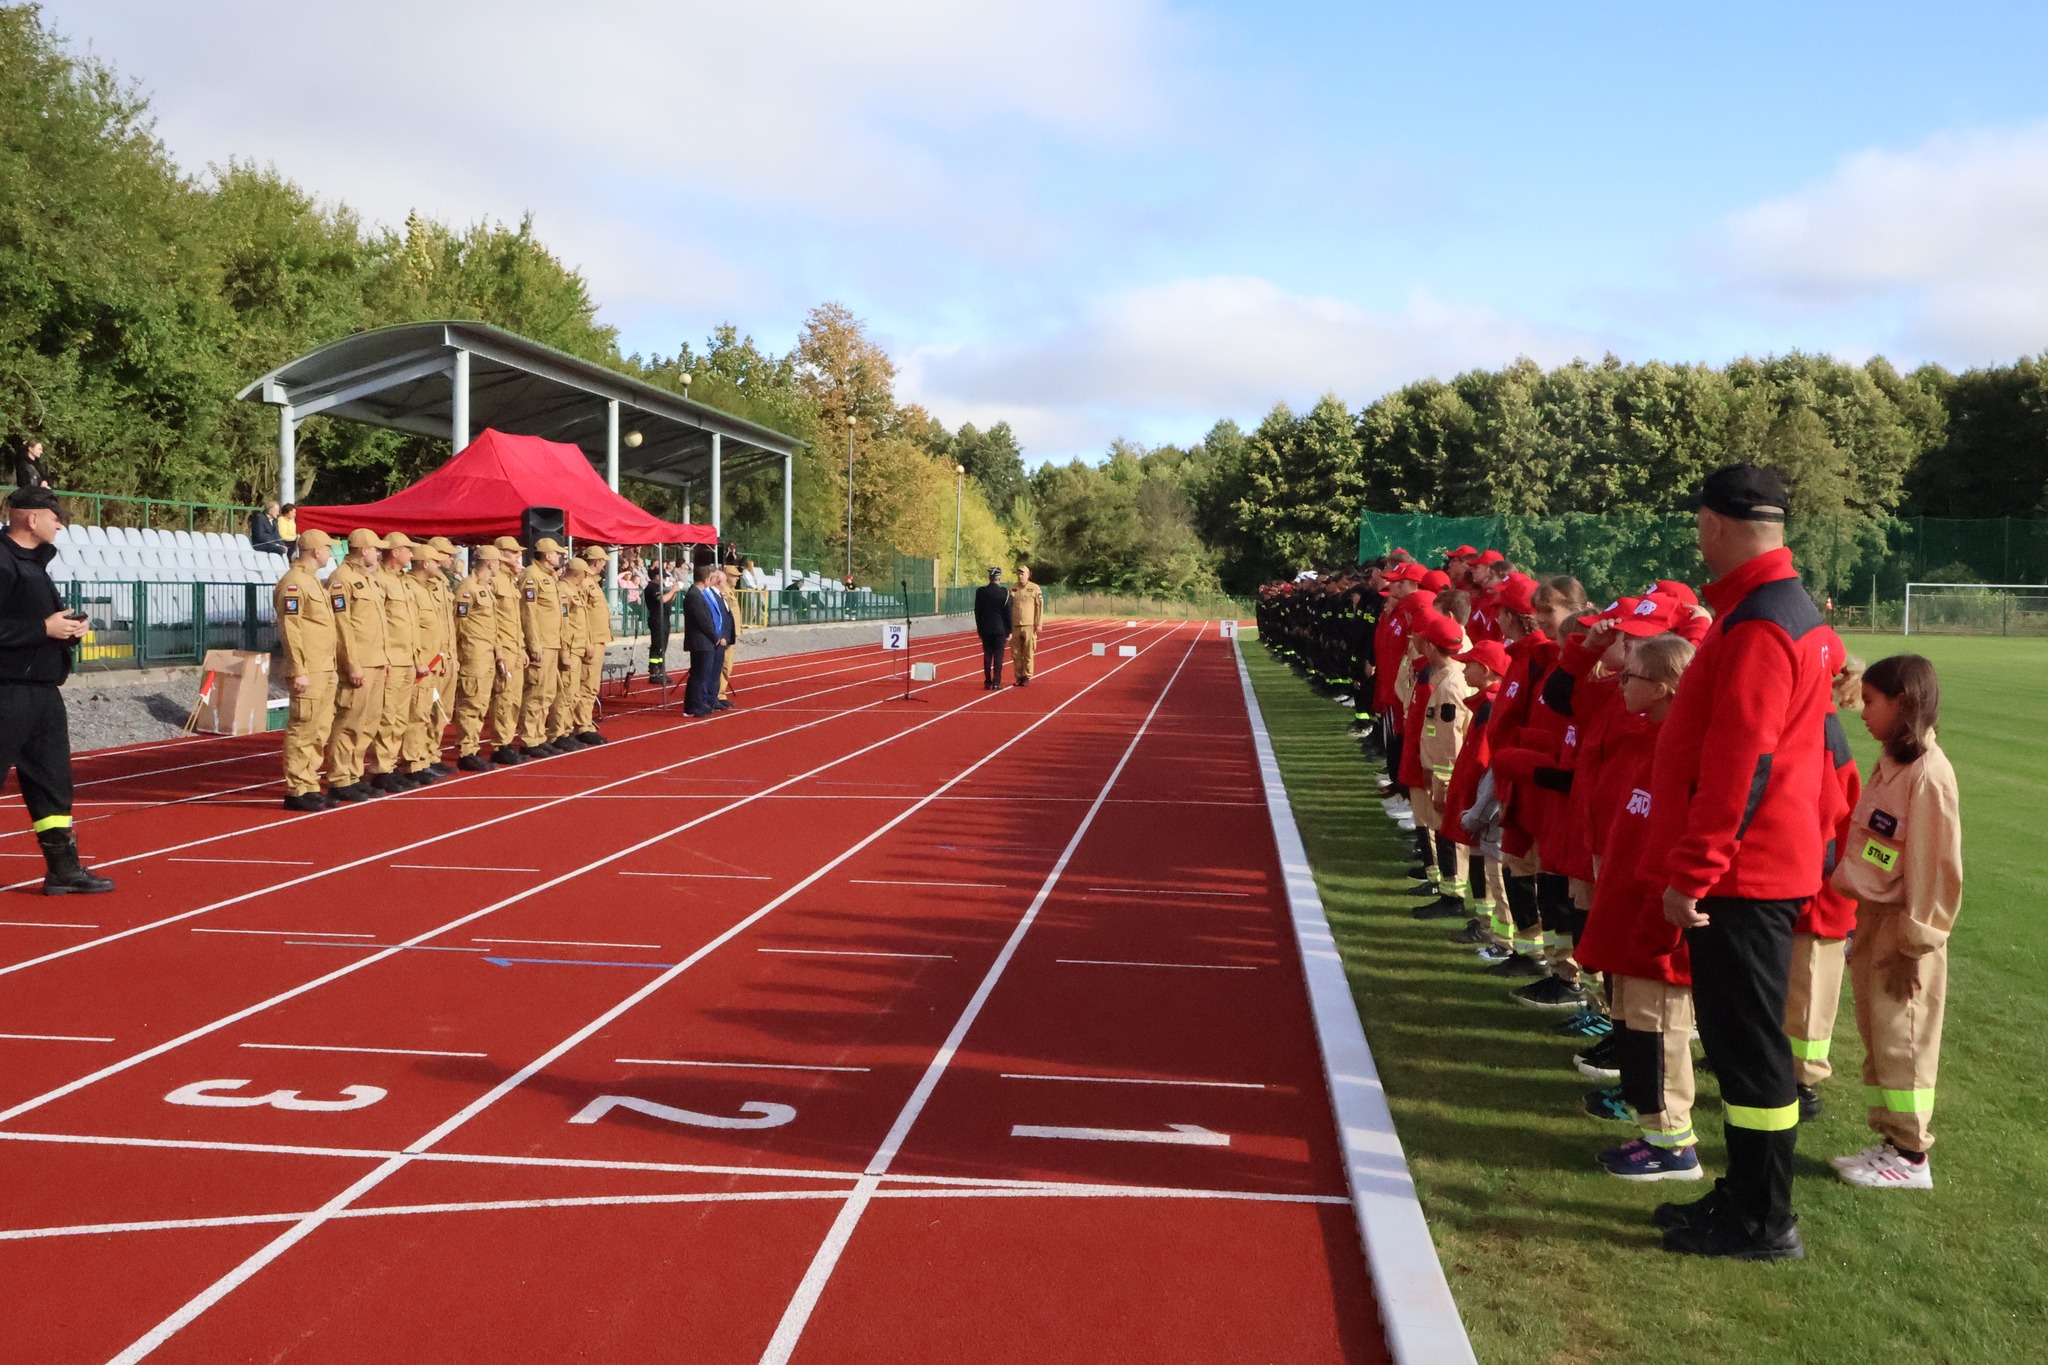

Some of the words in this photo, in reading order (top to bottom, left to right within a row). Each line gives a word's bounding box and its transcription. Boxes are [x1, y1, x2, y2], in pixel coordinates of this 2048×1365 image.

[891, 634, 900, 648] 2
[1226, 627, 1231, 636] 1
[164, 1079, 388, 1111] 3
[567, 1095, 797, 1129] 2
[1011, 1124, 1231, 1146] 1
